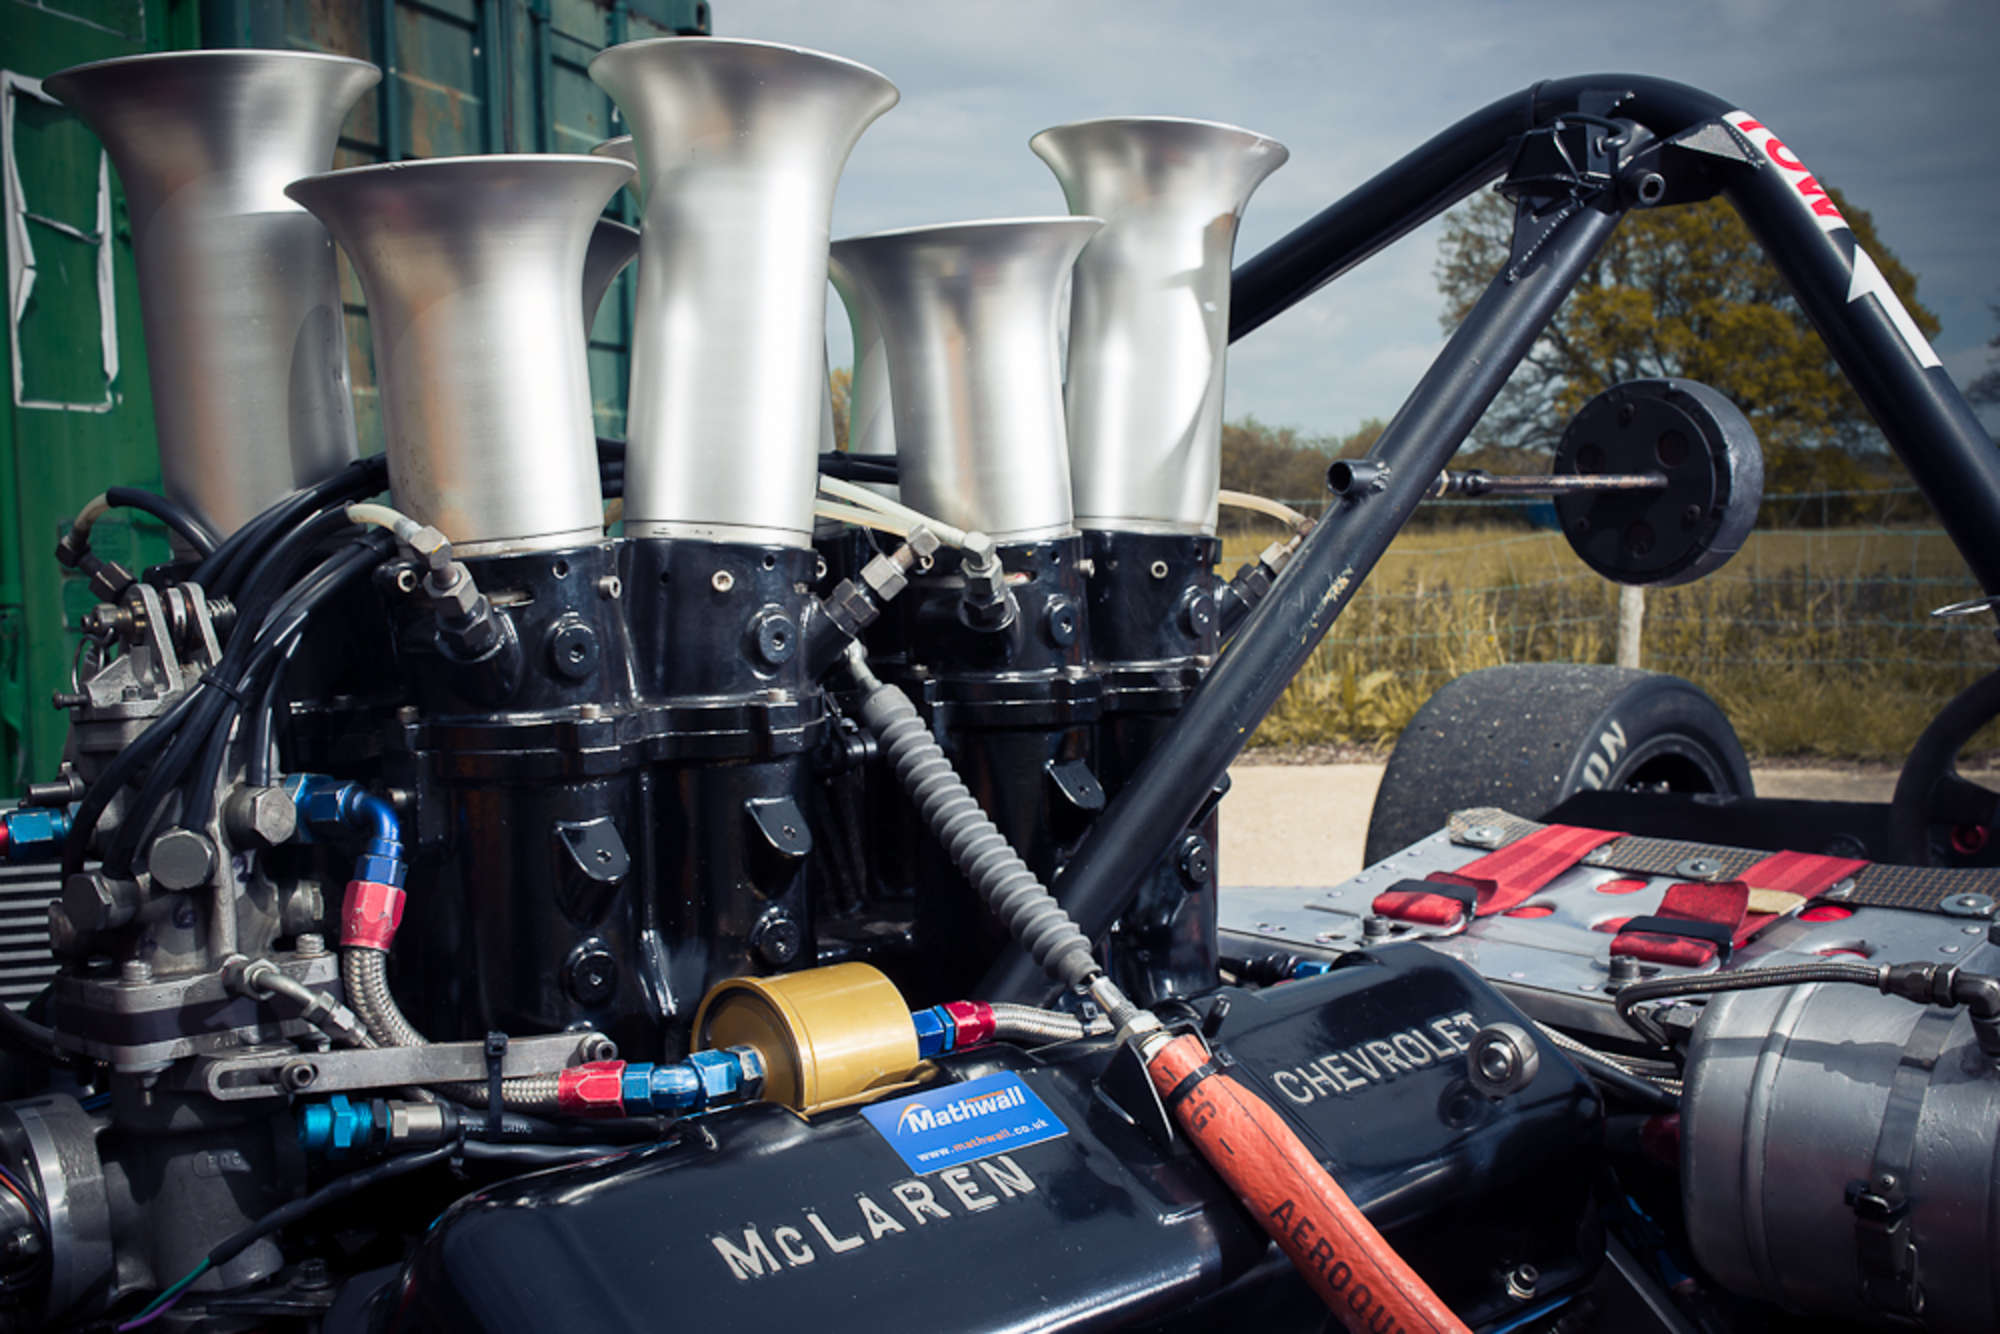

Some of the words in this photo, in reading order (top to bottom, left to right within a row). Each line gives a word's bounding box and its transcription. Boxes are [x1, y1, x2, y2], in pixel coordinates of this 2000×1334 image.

[1272, 1011, 1482, 1104] CHEVROLET
[898, 1085, 1026, 1135] Mathwall
[916, 1117, 1049, 1163] www.mathwall.co.uk
[1269, 1199, 1407, 1334] AEROQU
